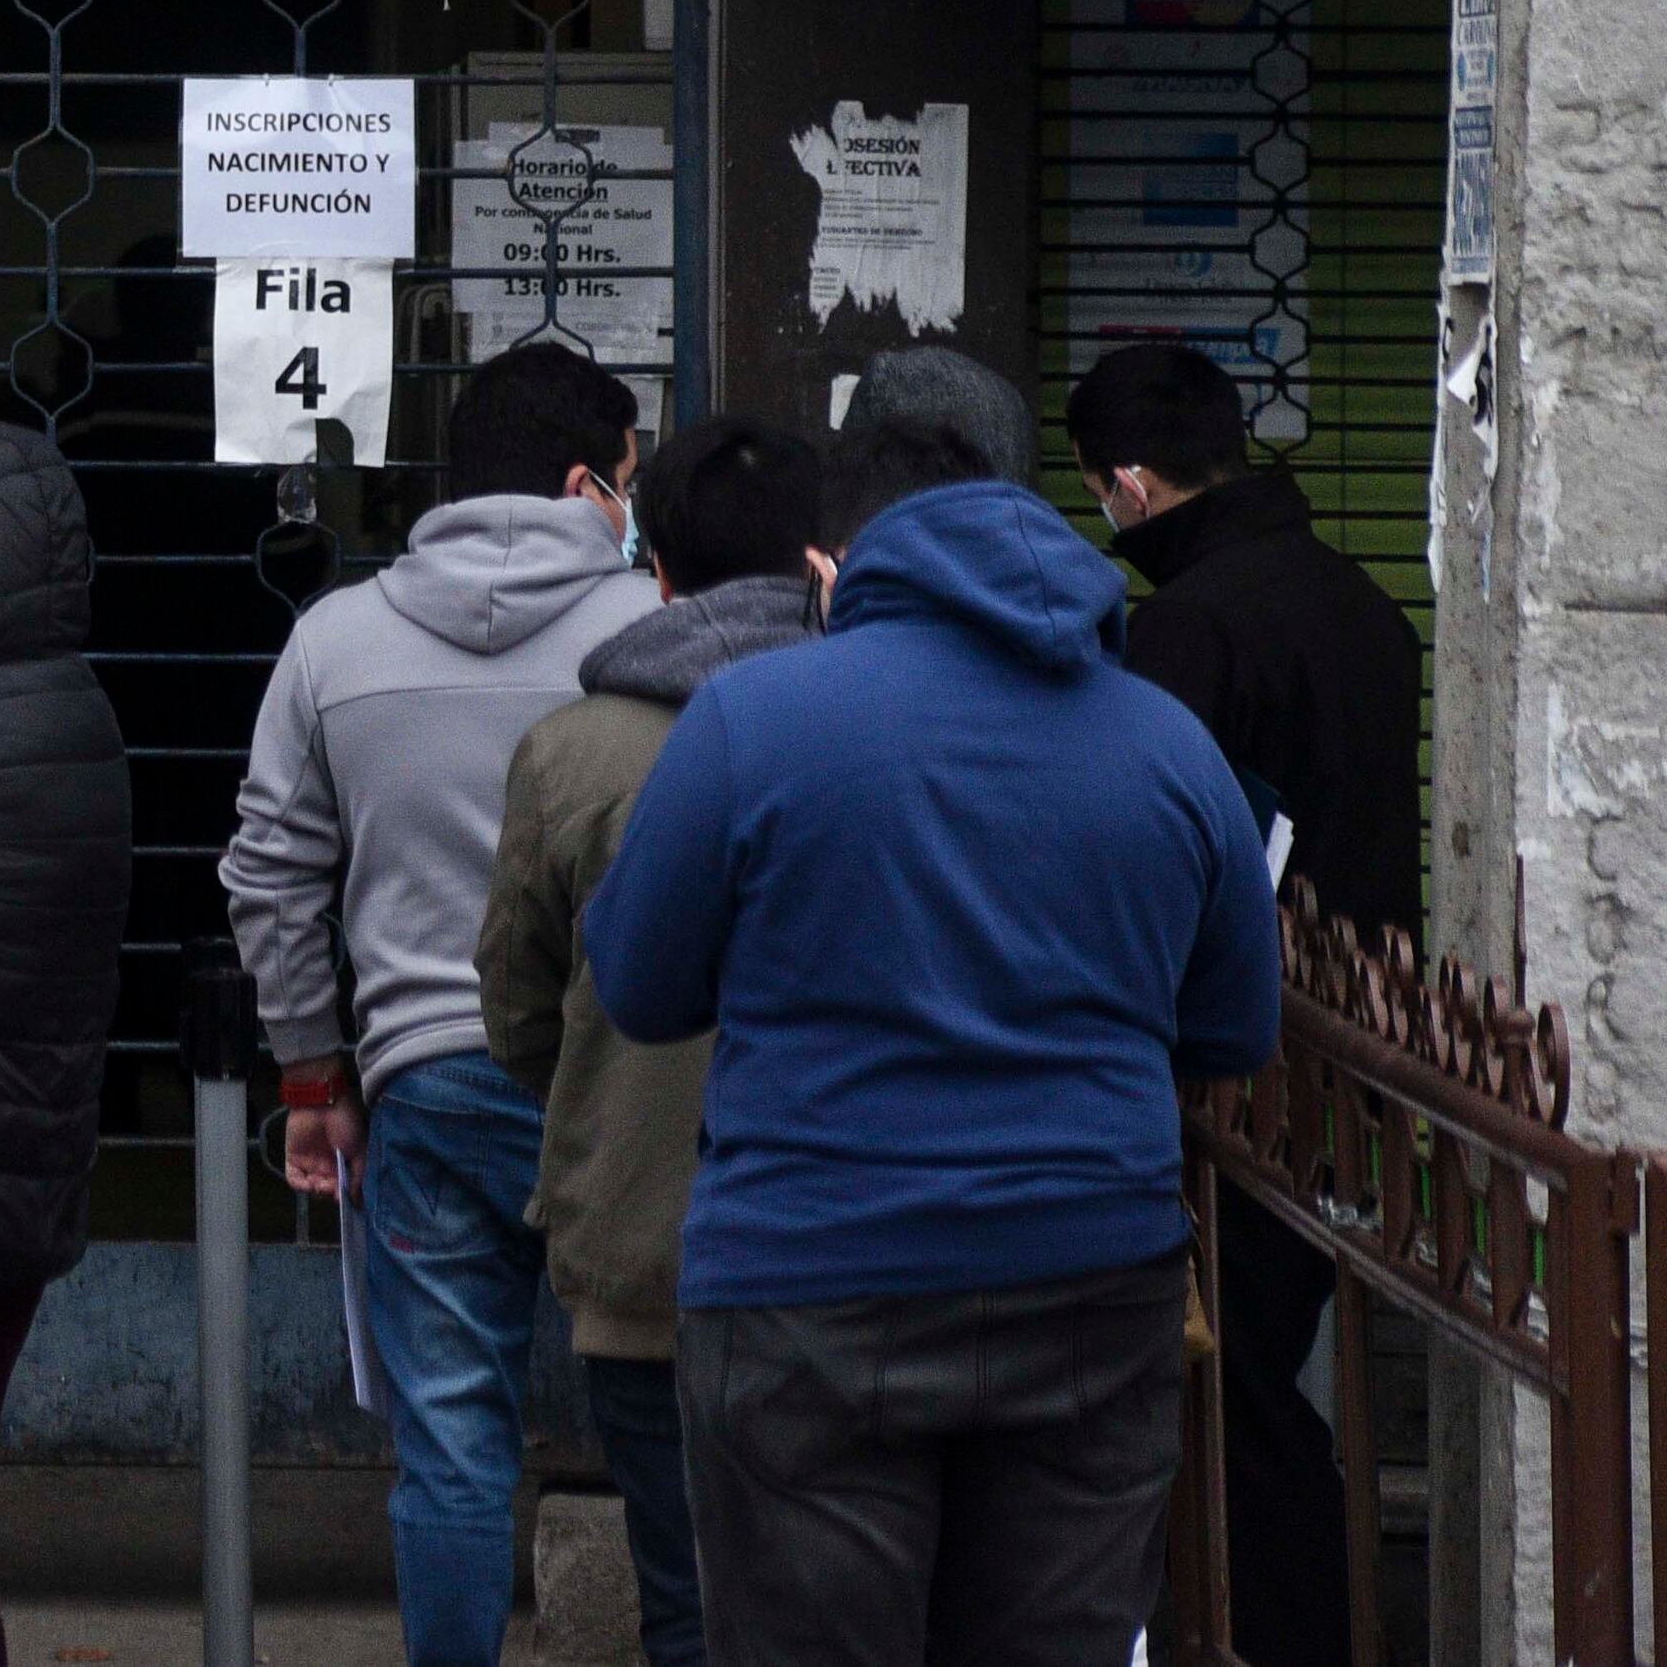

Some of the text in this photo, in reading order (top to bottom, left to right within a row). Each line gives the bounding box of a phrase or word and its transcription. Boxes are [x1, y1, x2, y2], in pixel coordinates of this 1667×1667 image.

[208, 113, 391, 133] INSCRIPCIONES
[844, 136, 922, 154] OSESIÓN
[209, 153, 389, 173] NACIMIENTO Y
[513, 158, 587, 176] Horario
[227, 189, 370, 213] DEFUNCIÓN
[474, 206, 496, 218] Por
[593, 207, 611, 219] de
[613, 208, 653, 221] Salud
[533, 223, 593, 235] Naional
[576, 244, 622, 263] Hrs.
[256, 268, 350, 313] Fila
[575, 278, 622, 298] Hrs.
[275, 347, 326, 409] 4
